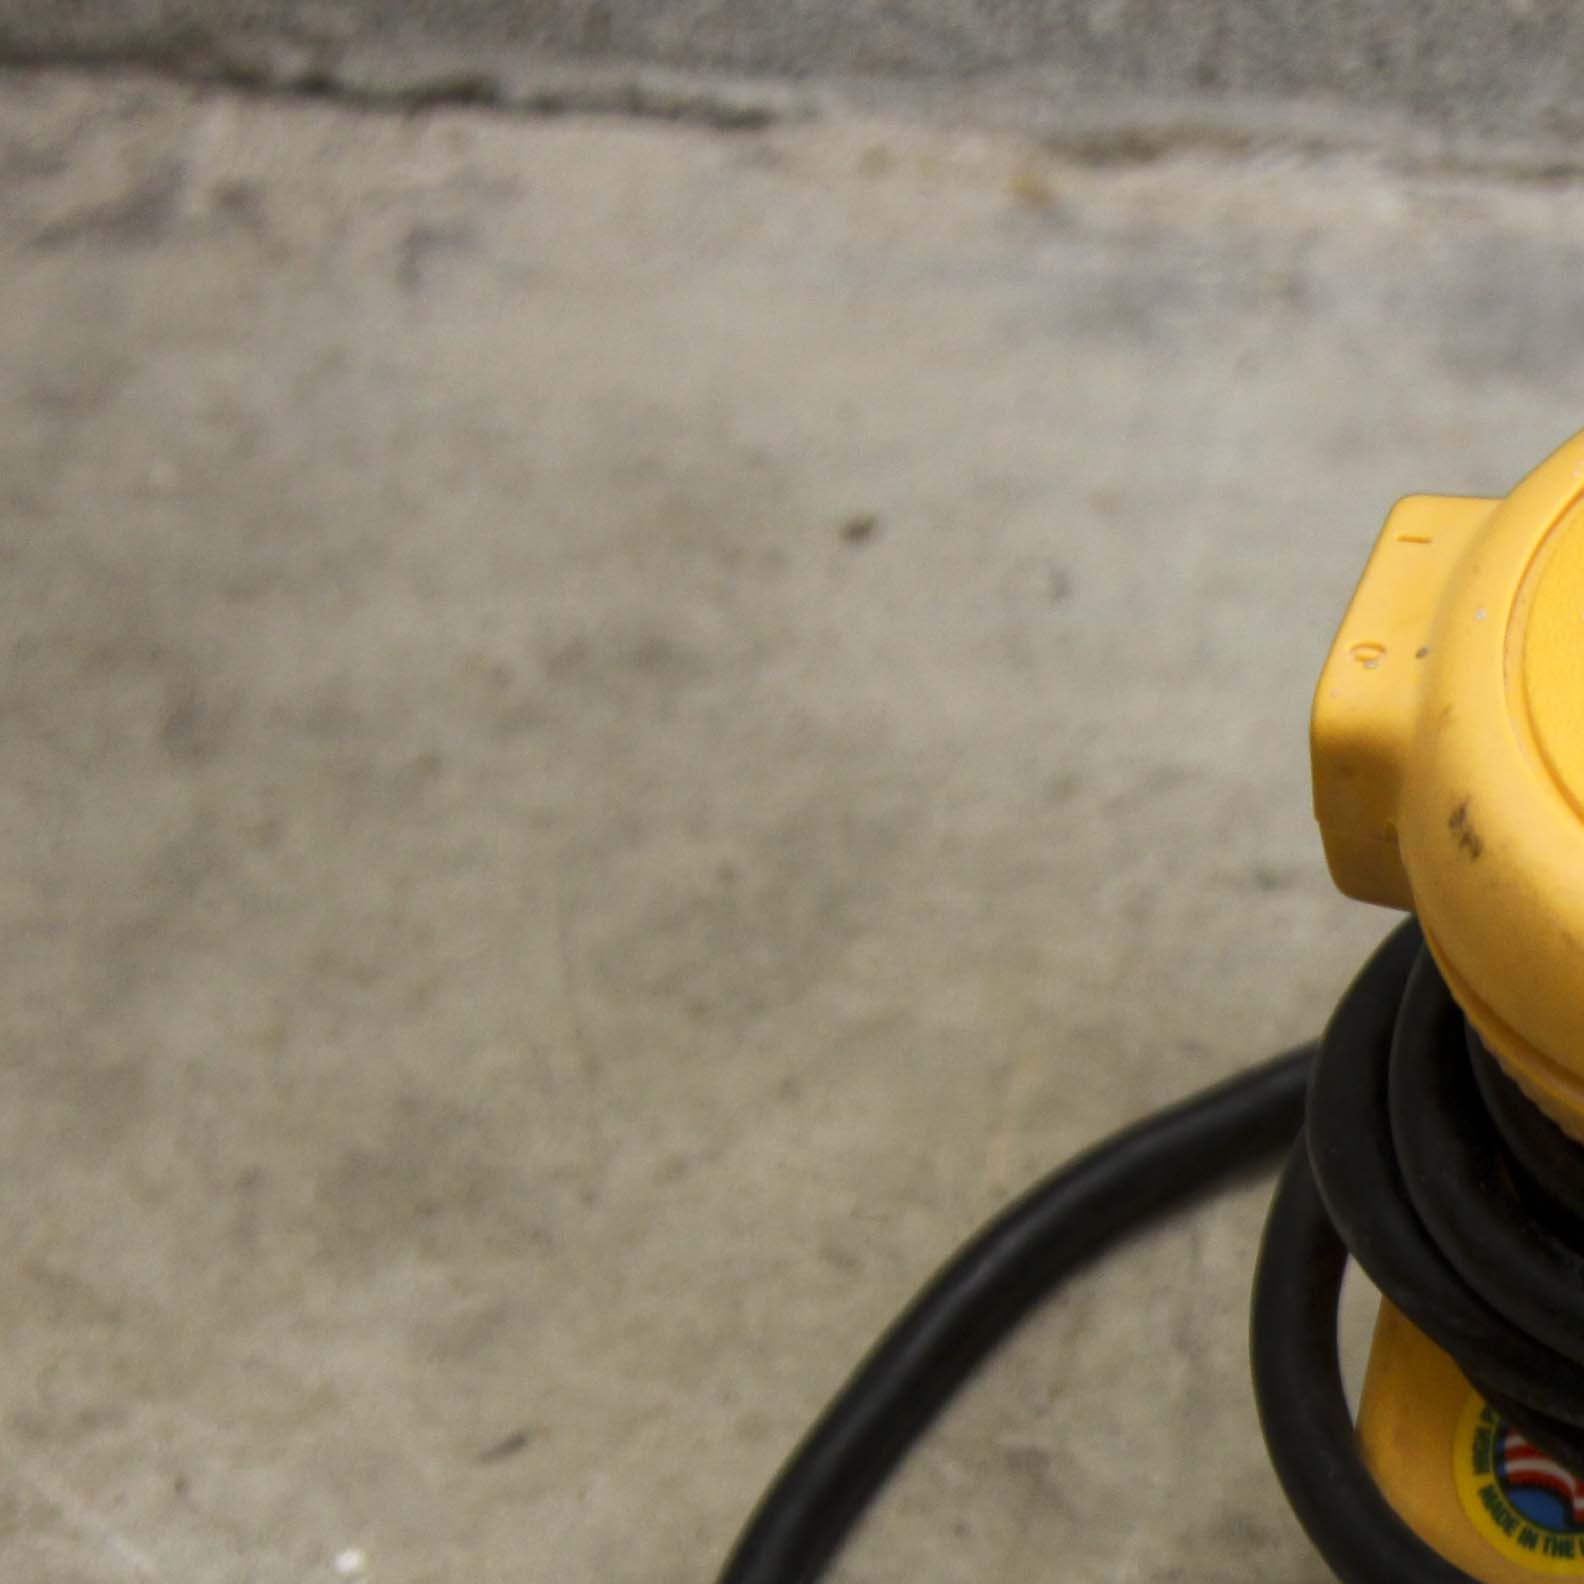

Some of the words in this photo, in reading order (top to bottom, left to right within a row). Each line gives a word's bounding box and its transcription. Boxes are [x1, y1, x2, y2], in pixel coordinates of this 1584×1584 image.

[1477, 1484, 1518, 1538] MADE
[1516, 1527, 1540, 1551] IN
[1541, 1535, 1576, 1558] THE
